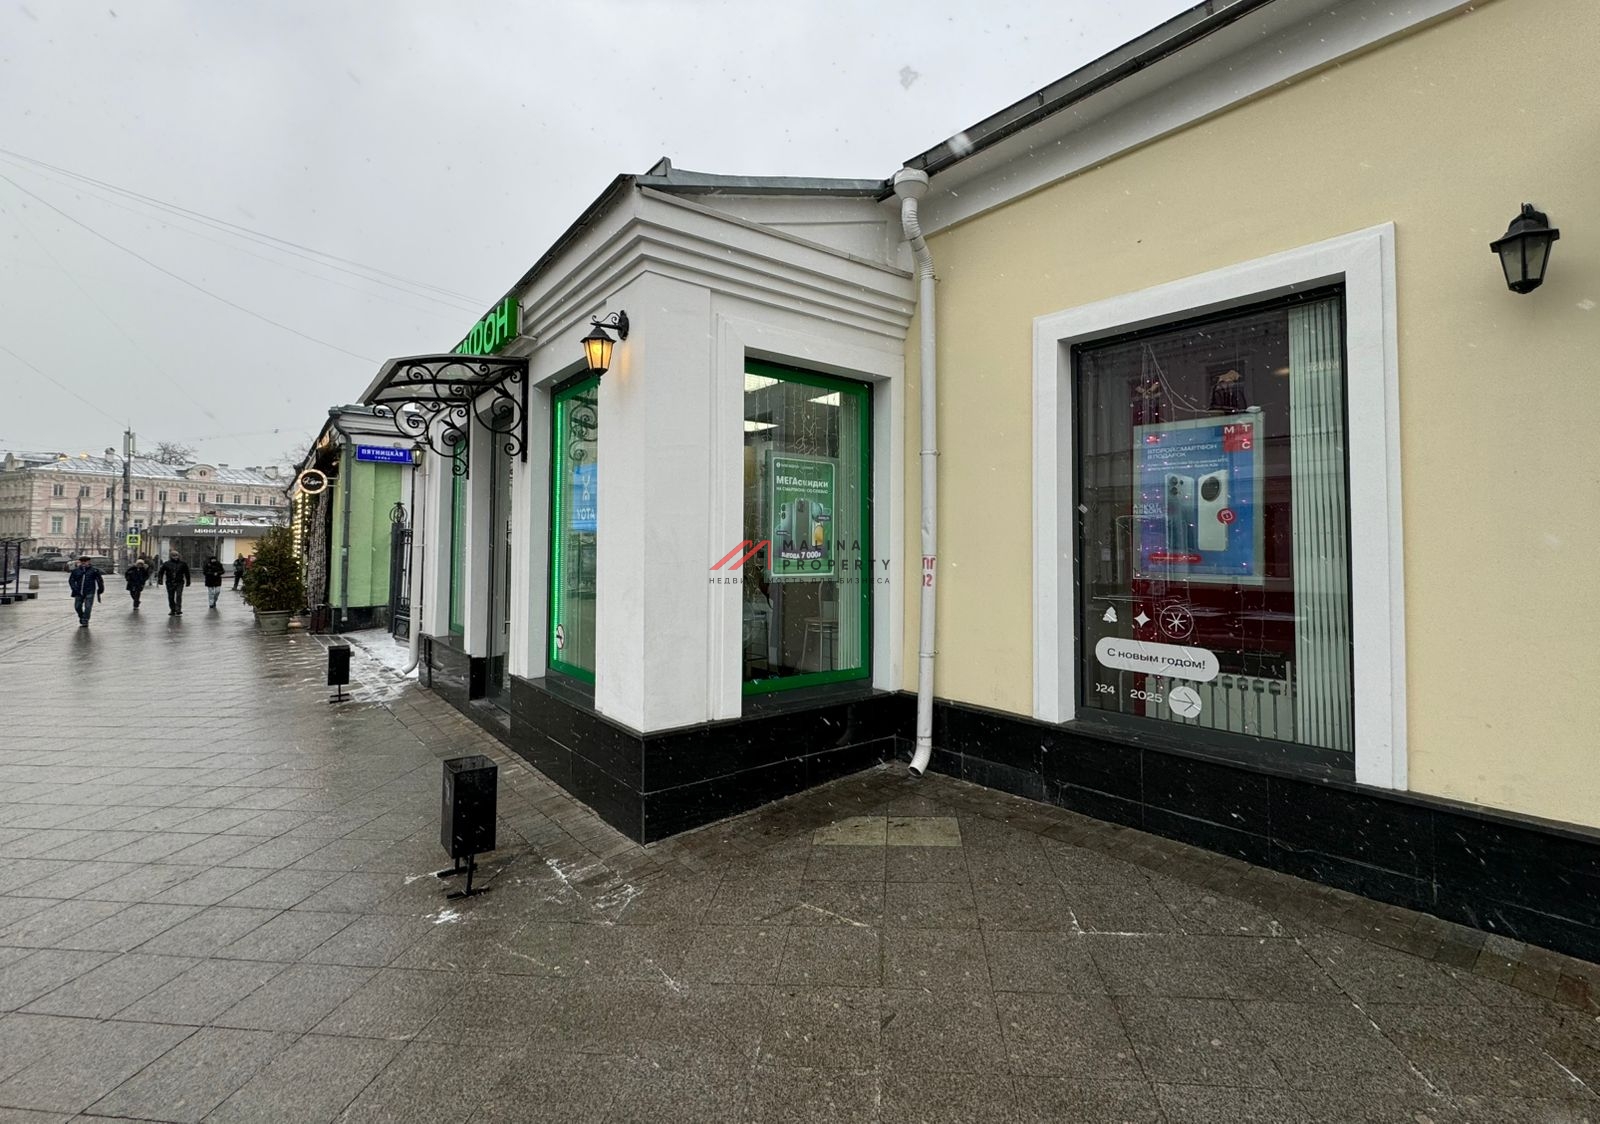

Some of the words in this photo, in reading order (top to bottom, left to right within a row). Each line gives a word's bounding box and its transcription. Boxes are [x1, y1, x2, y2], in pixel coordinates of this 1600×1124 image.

[361, 449, 404, 457] ПЯТНИЦКАЯ
[576, 508, 596, 521] YOTA
[922, 573, 933, 587] 12
[1107, 648, 1116, 657] С
[1118, 651, 1159, 663] новым
[1161, 656, 1206, 670] годом!
[1130, 689, 1163, 703] 2025
